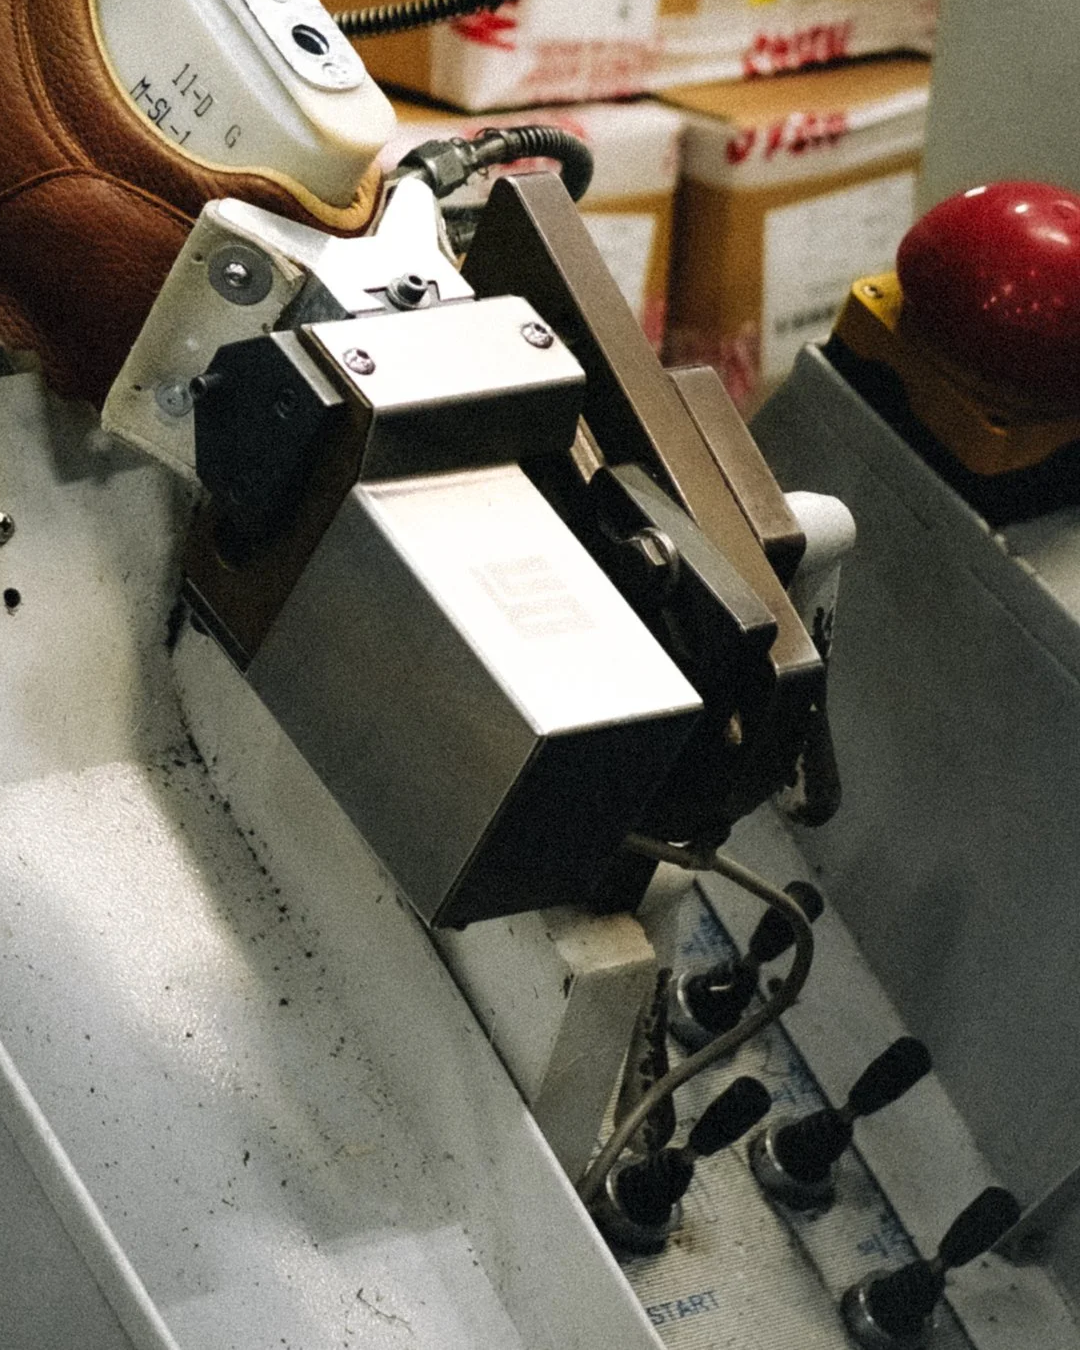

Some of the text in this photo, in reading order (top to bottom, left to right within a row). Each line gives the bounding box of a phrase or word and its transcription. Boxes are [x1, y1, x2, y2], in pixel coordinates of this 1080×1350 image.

[172, 63, 242, 149] 11-D G
[646, 1291, 720, 1326] START
